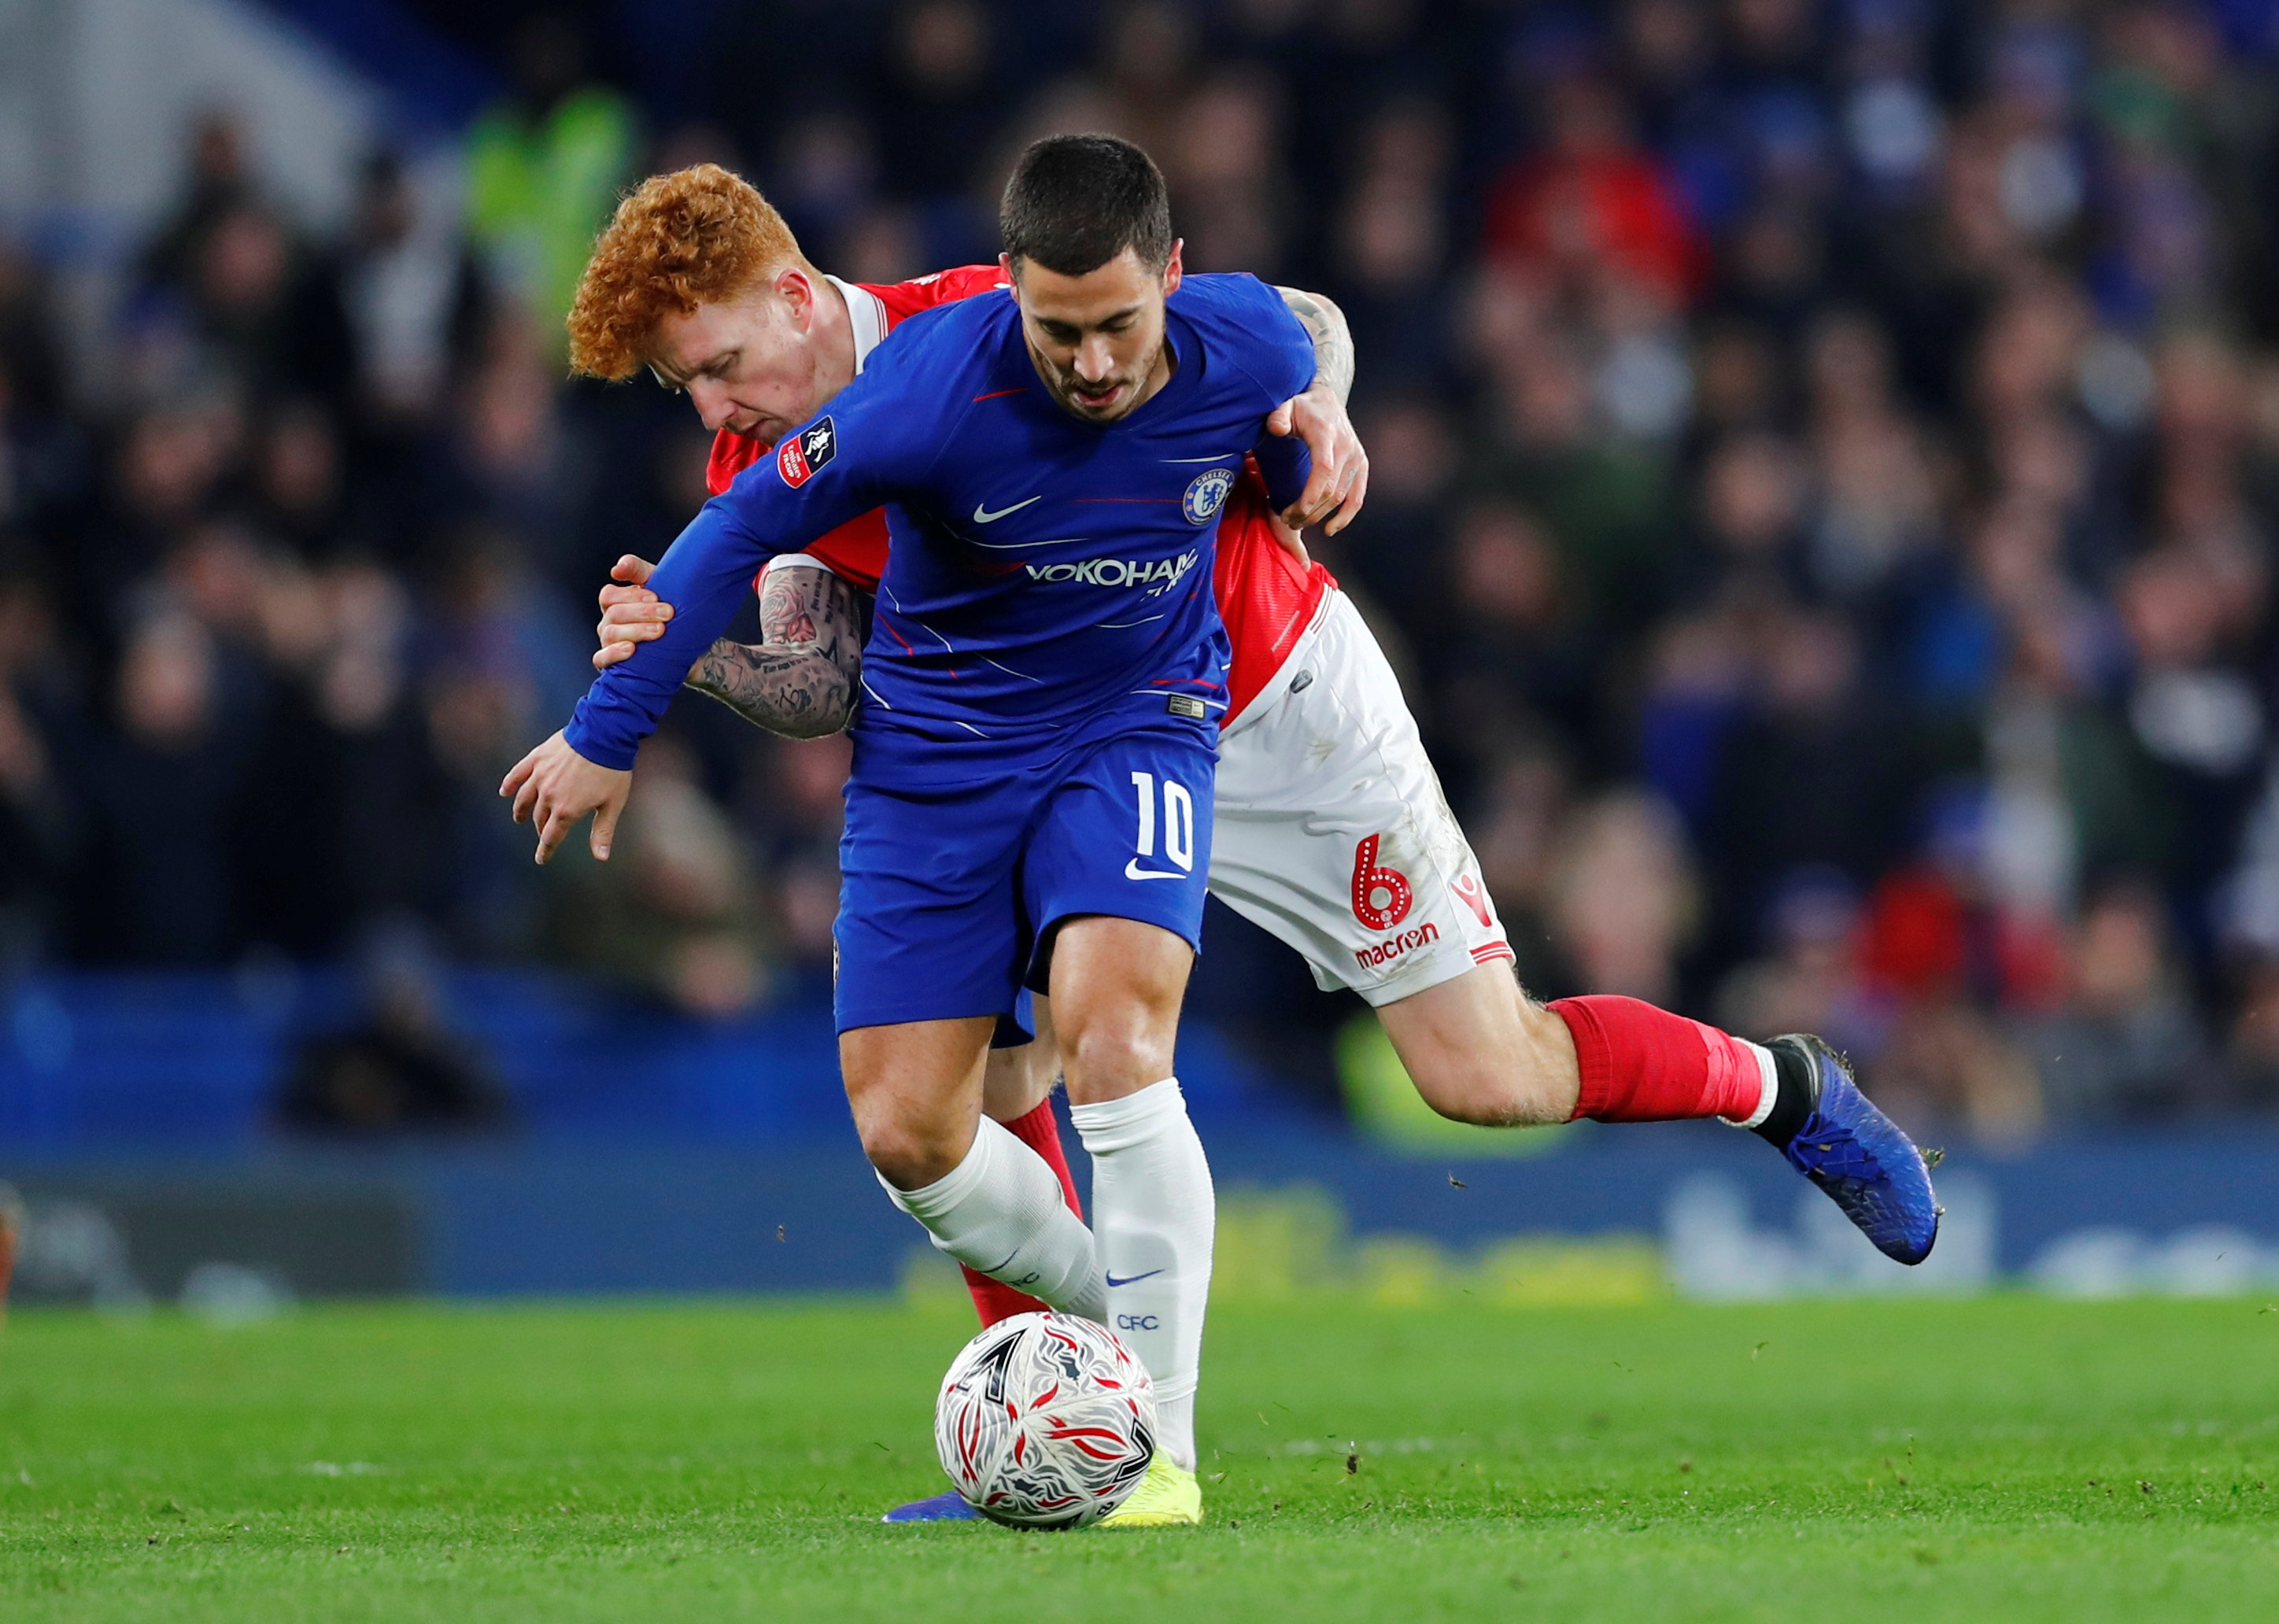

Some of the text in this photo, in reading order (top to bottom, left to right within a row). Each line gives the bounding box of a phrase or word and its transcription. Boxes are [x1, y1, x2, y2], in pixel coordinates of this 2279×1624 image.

[1195, 471, 1231, 487] CHELSEA
[1131, 771, 1193, 873] 10
[1351, 832, 1413, 931] 6
[1355, 922, 1440, 969] macron
[1117, 1314, 1159, 1331] CFC
